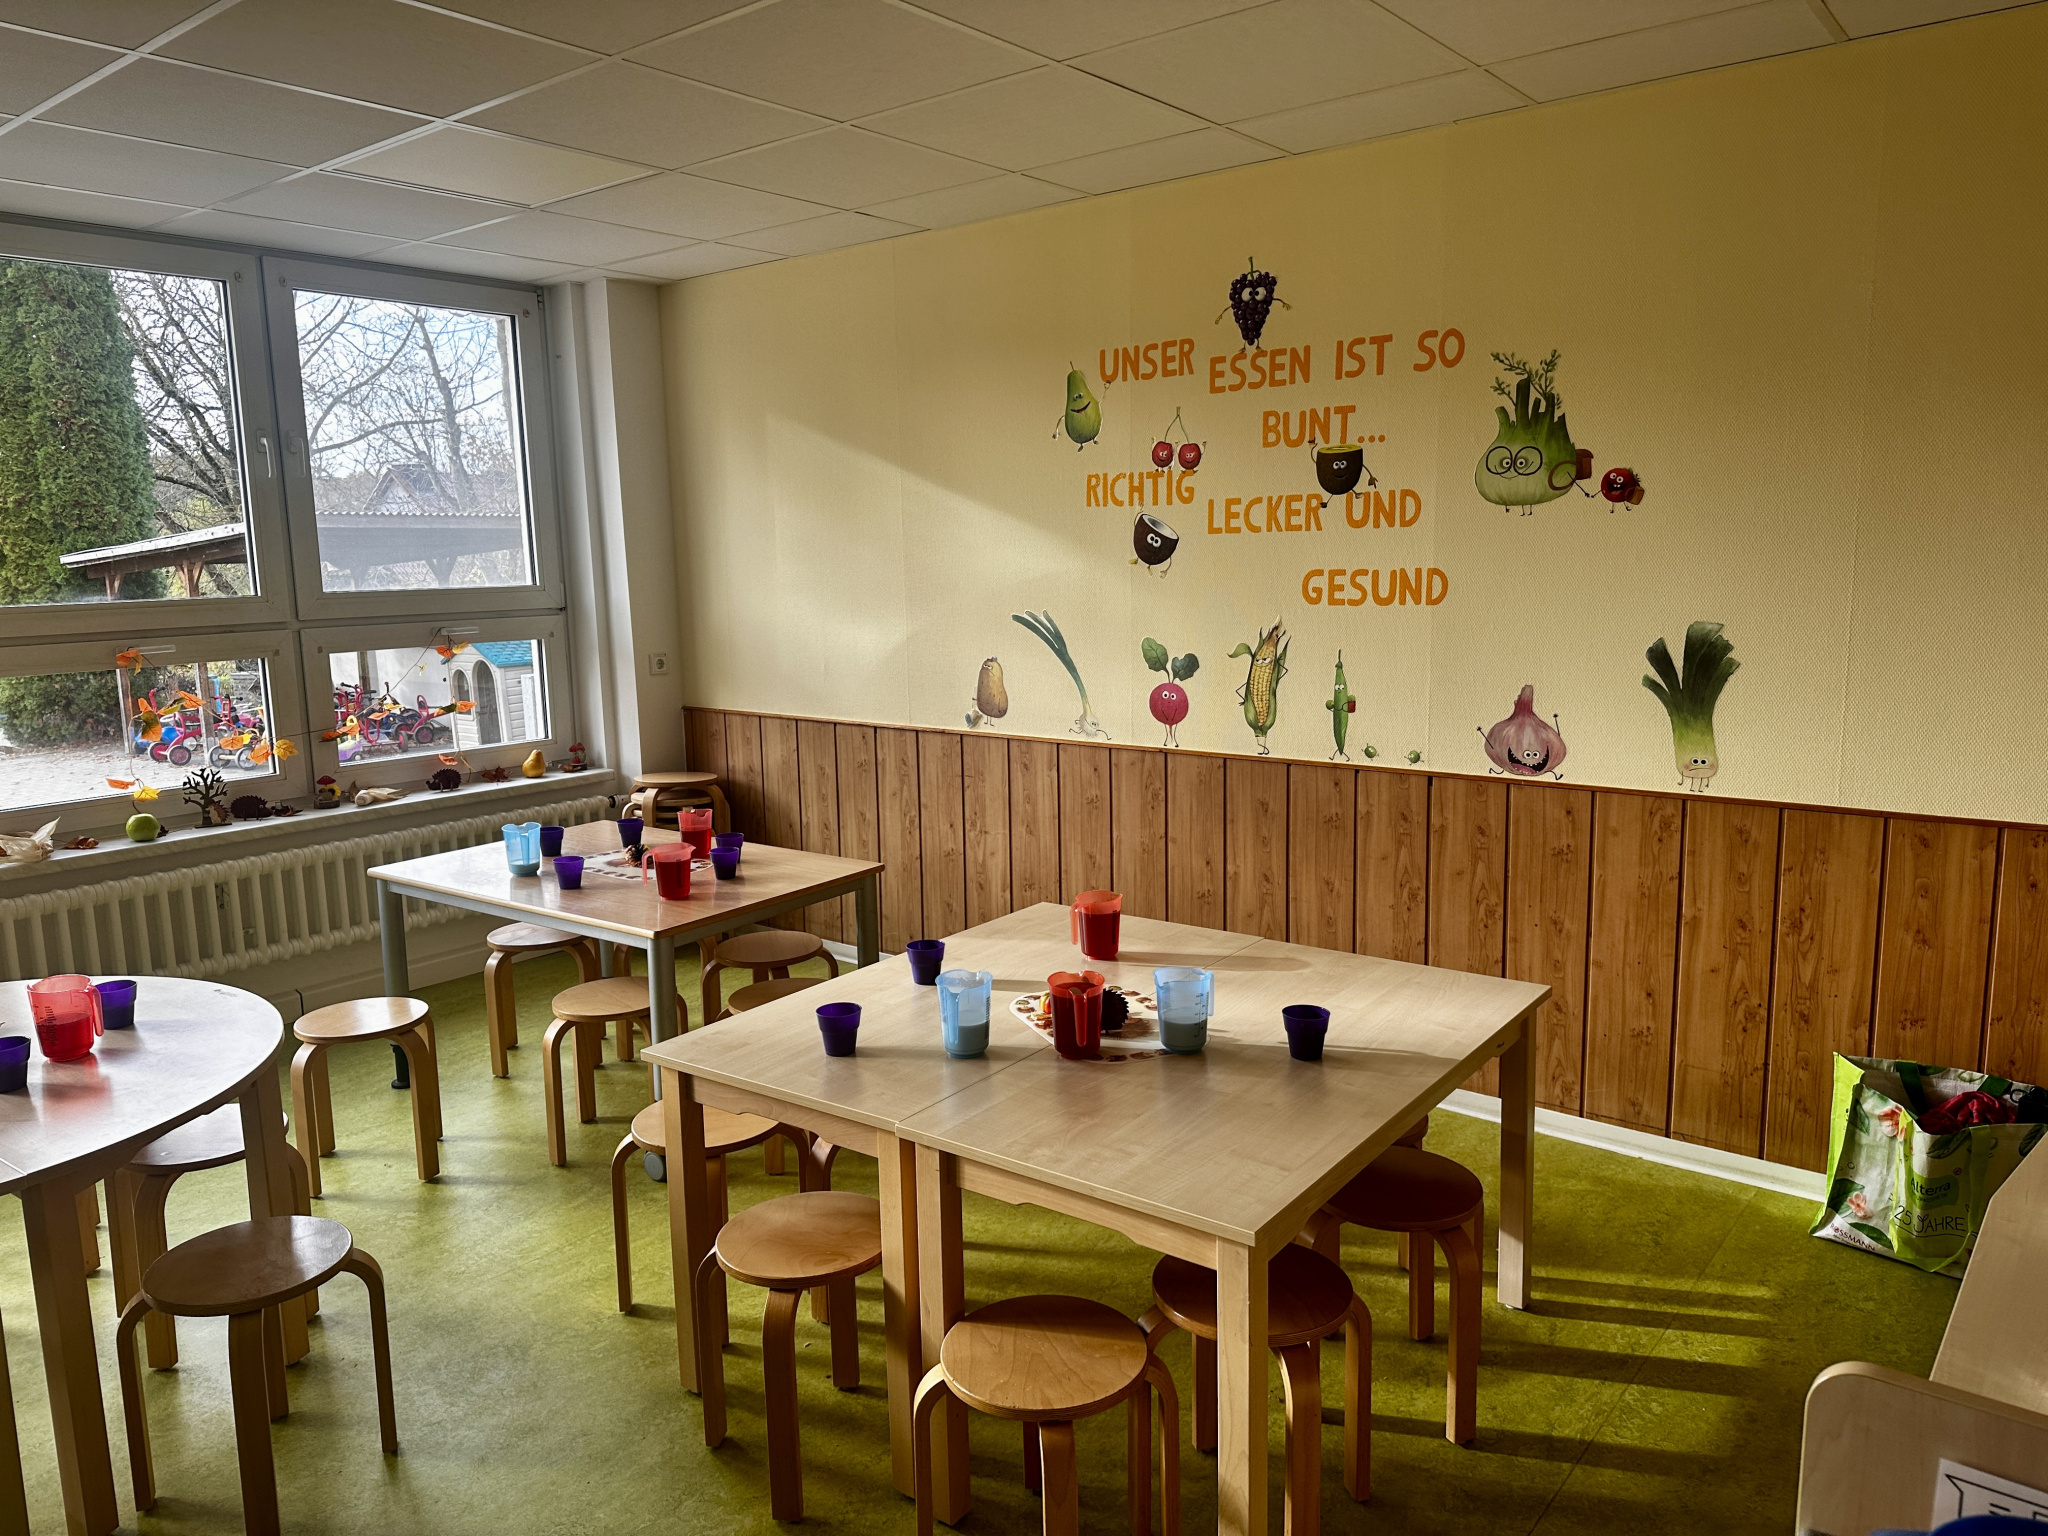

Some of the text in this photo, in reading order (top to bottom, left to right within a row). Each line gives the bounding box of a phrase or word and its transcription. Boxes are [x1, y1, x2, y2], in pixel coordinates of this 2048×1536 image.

[1099, 328, 1466, 394] UNSER ESSEN IST SO
[1086, 470, 1422, 535] RICHTIG LECKER UND
[1302, 567, 1449, 606] GESUND
[1910, 1177, 1951, 1197] Alterra
[1893, 1205, 1967, 1234] 25 JAHRE
